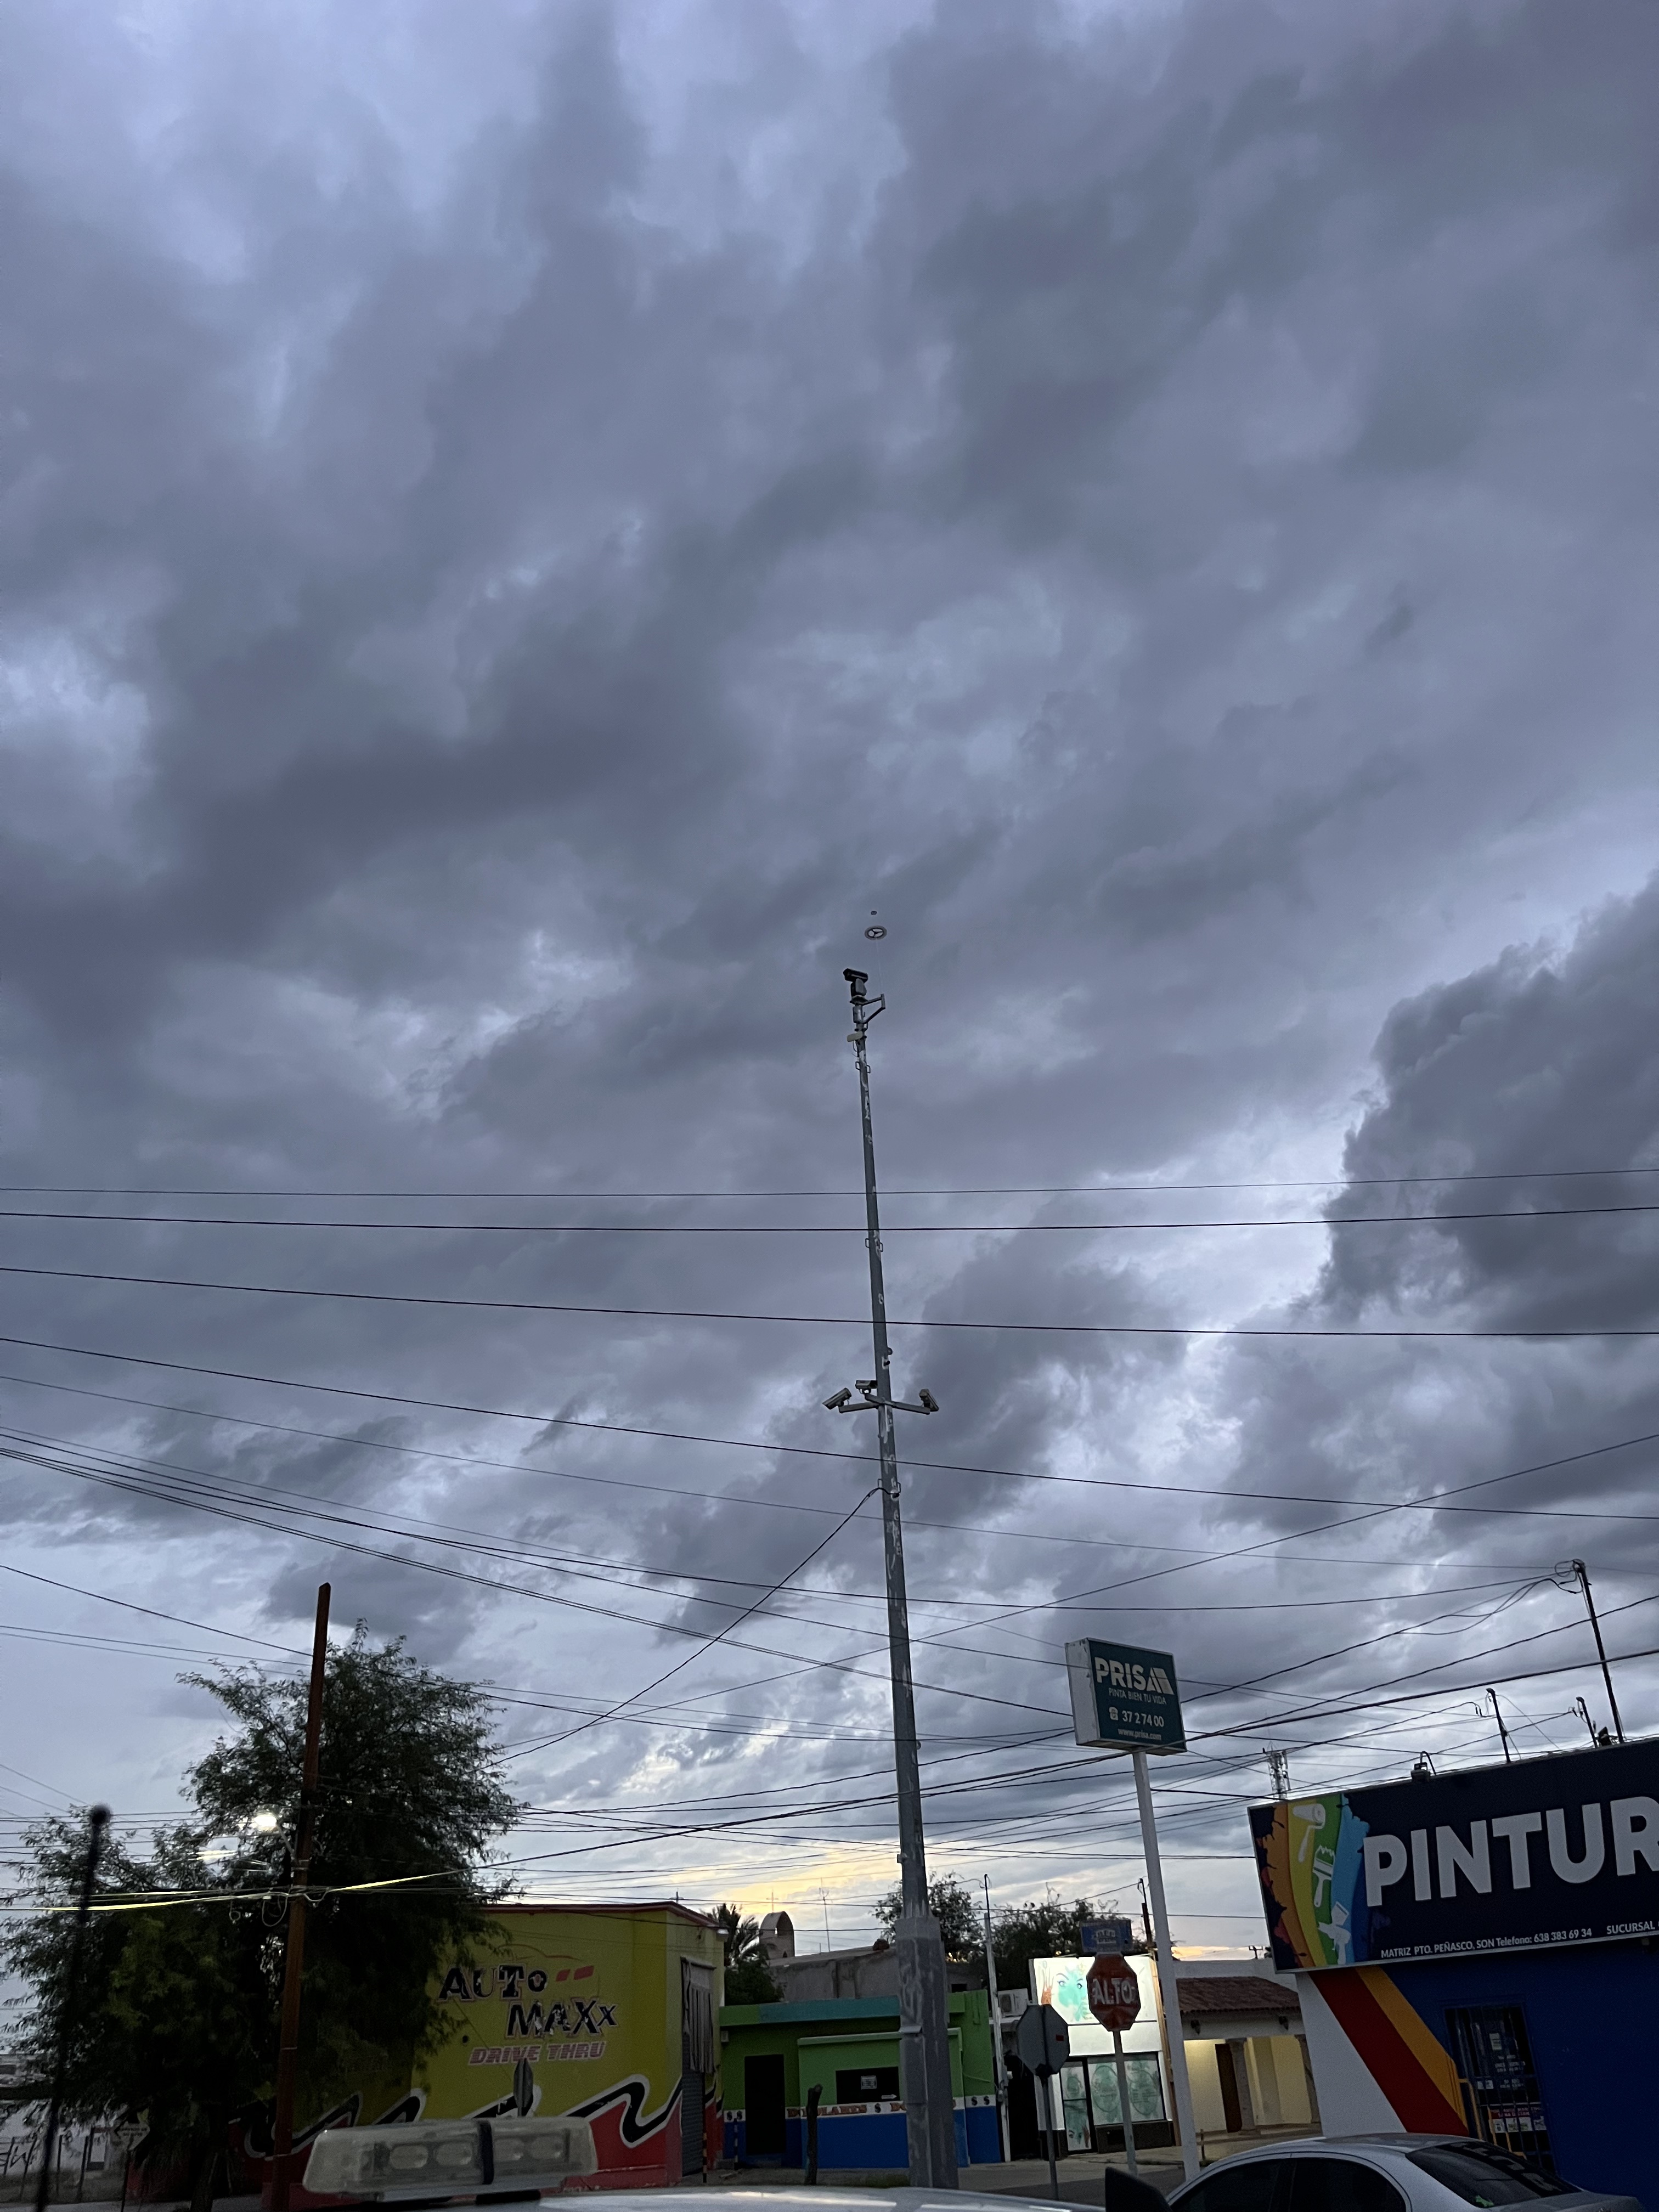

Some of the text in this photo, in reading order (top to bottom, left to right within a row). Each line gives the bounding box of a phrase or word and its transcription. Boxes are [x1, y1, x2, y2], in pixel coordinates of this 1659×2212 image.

[1094, 1657, 1175, 1695] PRISA
[1108, 1688, 1167, 1705] PINTA BIEN TU VIDA
[1122, 1710, 1133, 1723] 37
[1153, 1715, 1164, 1727] 00
[1381, 1947, 1411, 1958] MATRIZ
[1476, 1938, 1494, 1949] SON
[1534, 1933, 1549, 1943] 638
[1551, 1931, 1567, 1940] 383
[1568, 1929, 1579, 1939] 69
[1581, 1928, 1592, 1937] 34
[1606, 1920, 1655, 1935] SUCURSAL
[1093, 1978, 1133, 2005] ALTO
[469, 2041, 606, 2066] DRIVE THRU
